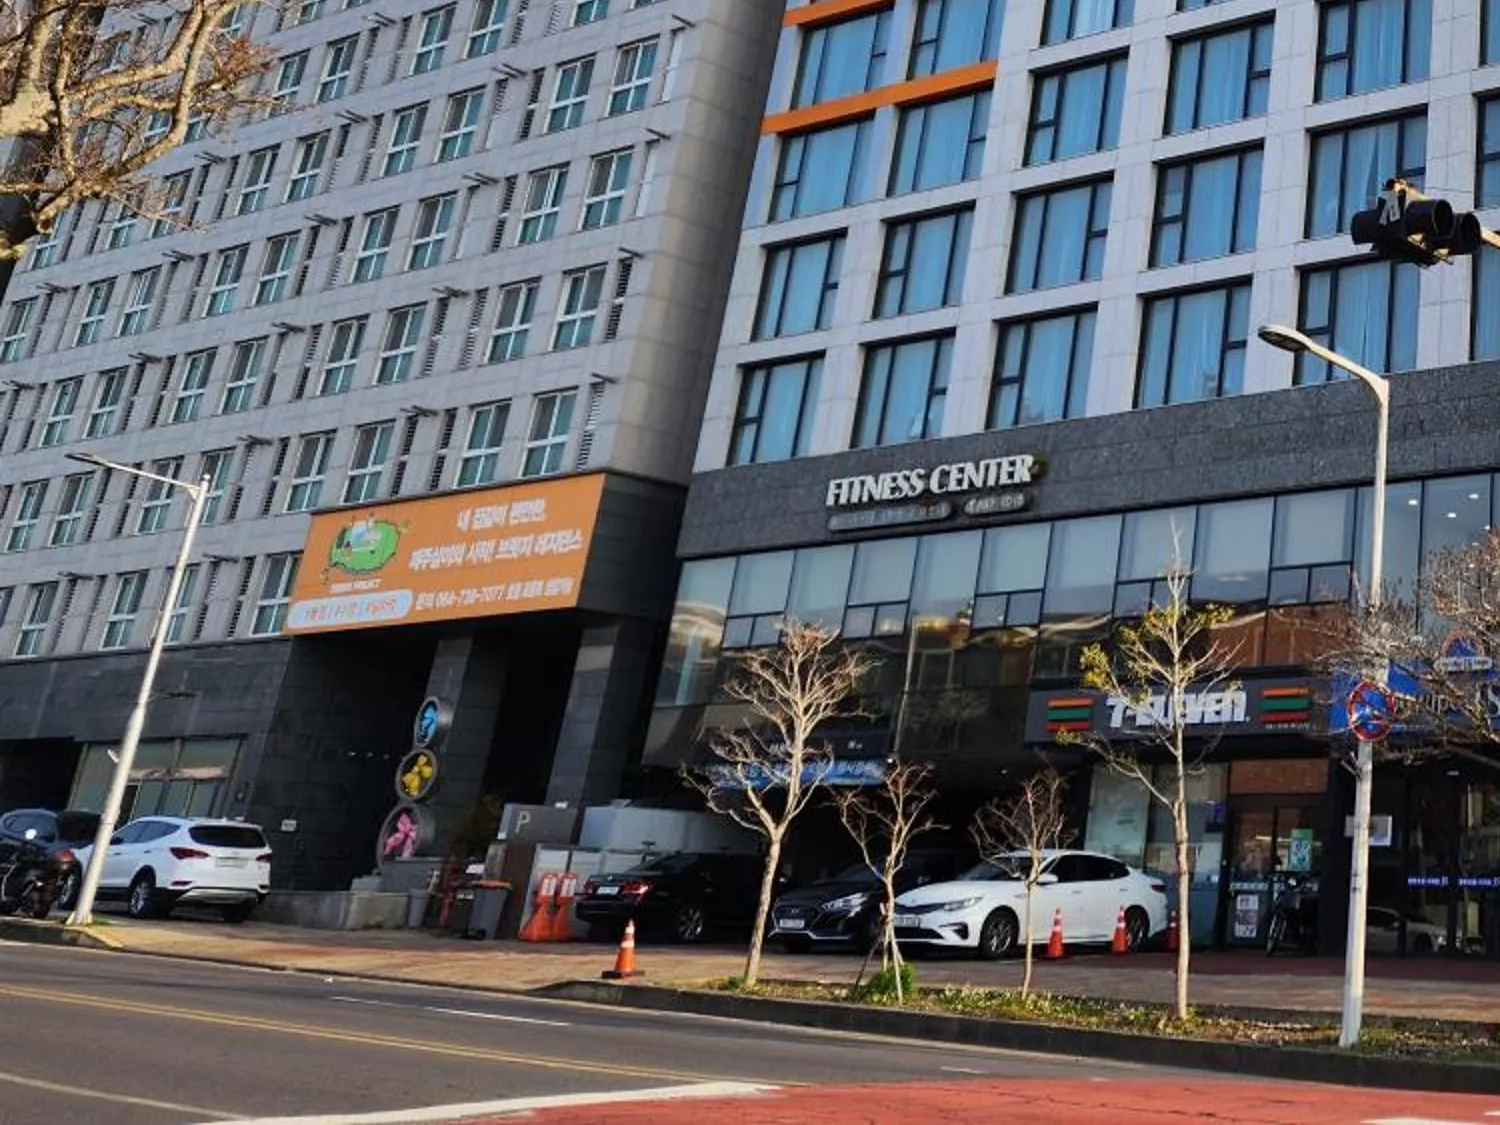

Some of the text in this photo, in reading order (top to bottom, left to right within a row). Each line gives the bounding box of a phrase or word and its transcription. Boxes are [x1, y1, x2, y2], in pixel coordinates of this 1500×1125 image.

[826, 468, 926, 506] FITNESS
[929, 454, 1035, 495] CENTER
[1105, 690, 1248, 728] 7-ELVEn
[515, 810, 530, 834] P
